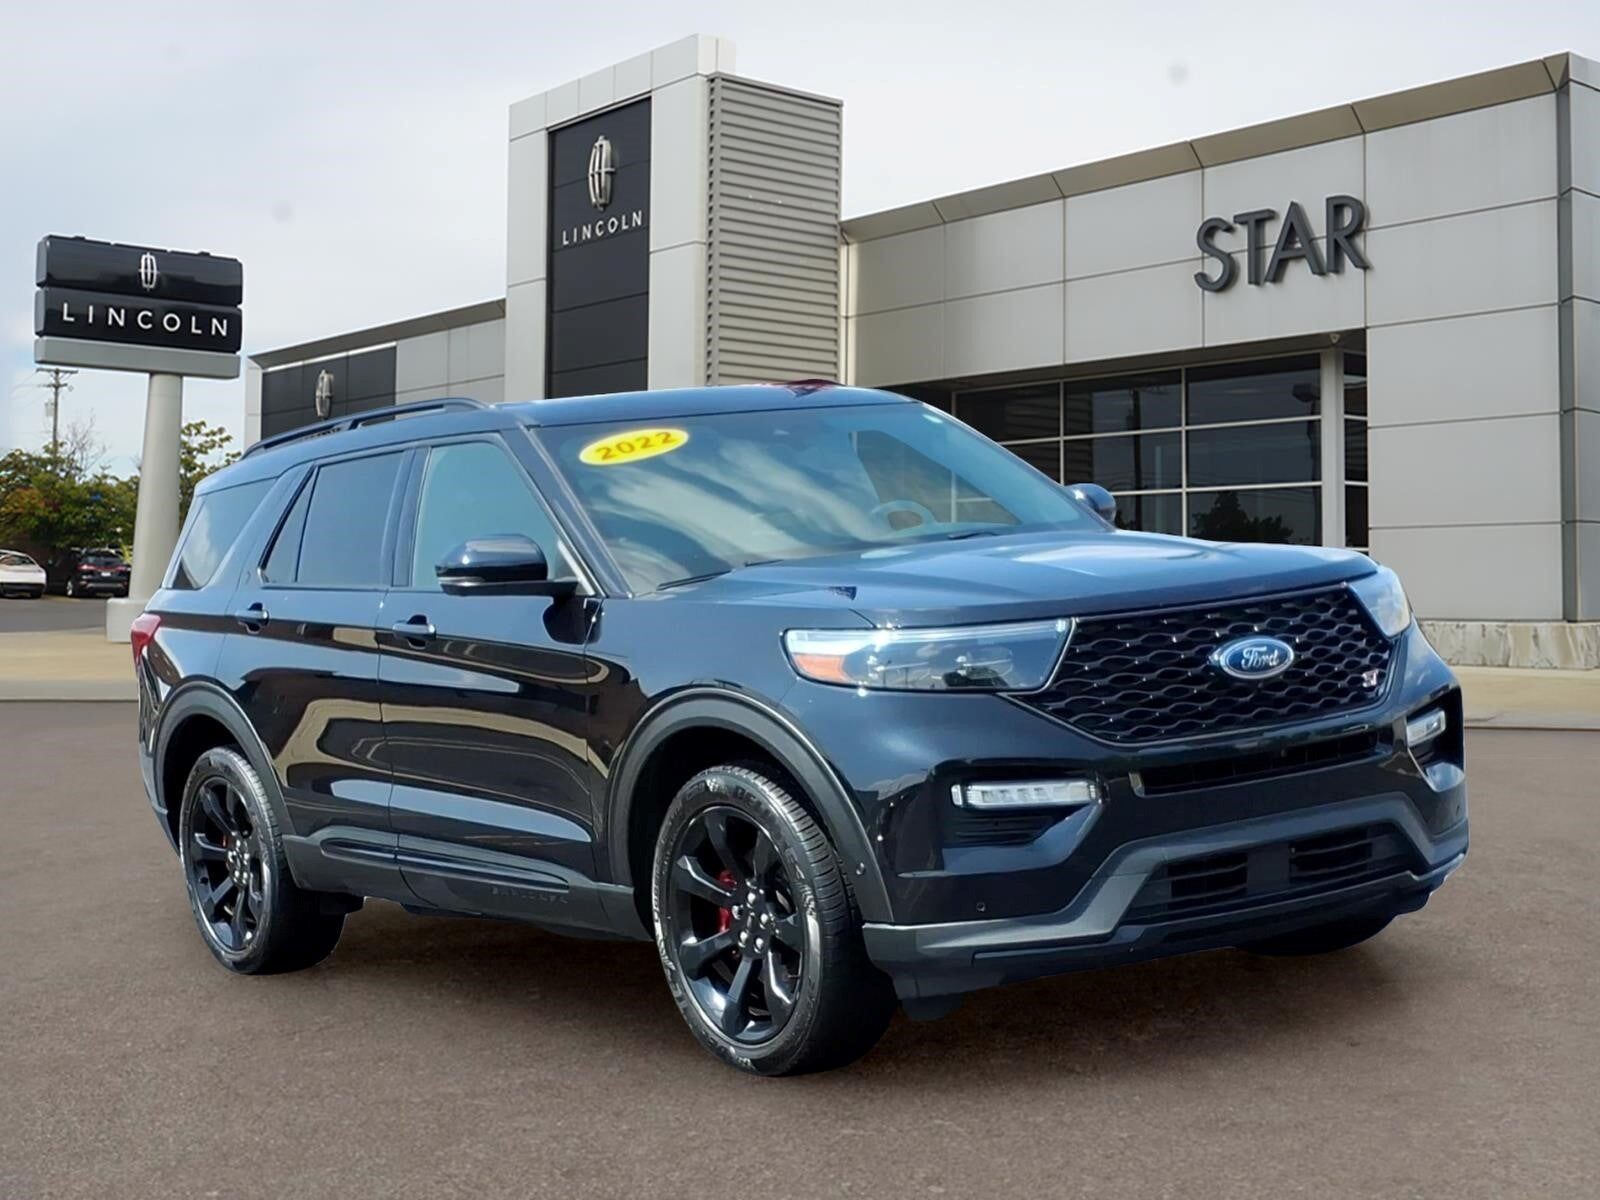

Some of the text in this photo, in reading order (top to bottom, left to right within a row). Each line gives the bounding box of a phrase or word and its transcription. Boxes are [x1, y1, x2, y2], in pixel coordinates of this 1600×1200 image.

[562, 210, 643, 246] LINCOLN
[1194, 194, 1371, 293] STAR
[62, 302, 228, 337] LINCOLN
[595, 431, 677, 461] 2022
